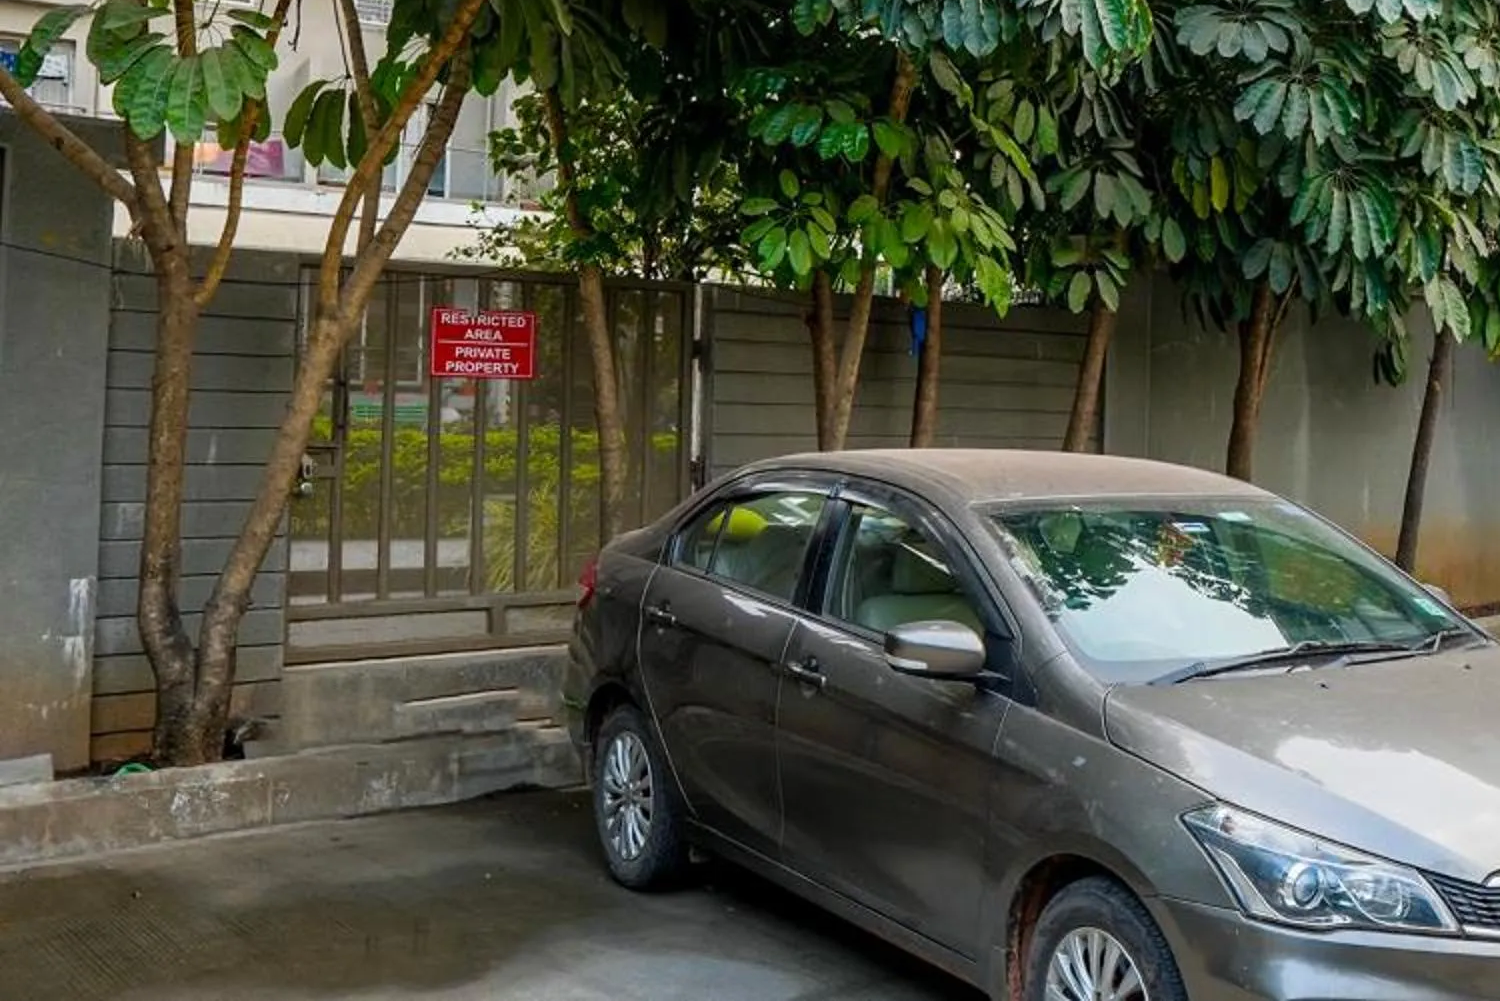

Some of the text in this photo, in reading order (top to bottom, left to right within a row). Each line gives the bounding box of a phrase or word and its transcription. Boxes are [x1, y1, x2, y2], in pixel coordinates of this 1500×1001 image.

[440, 312, 527, 328] RESTRICTED
[464, 328, 503, 341] AREA
[455, 346, 511, 360] PRIVATE
[445, 360, 519, 374] PROPERTY
